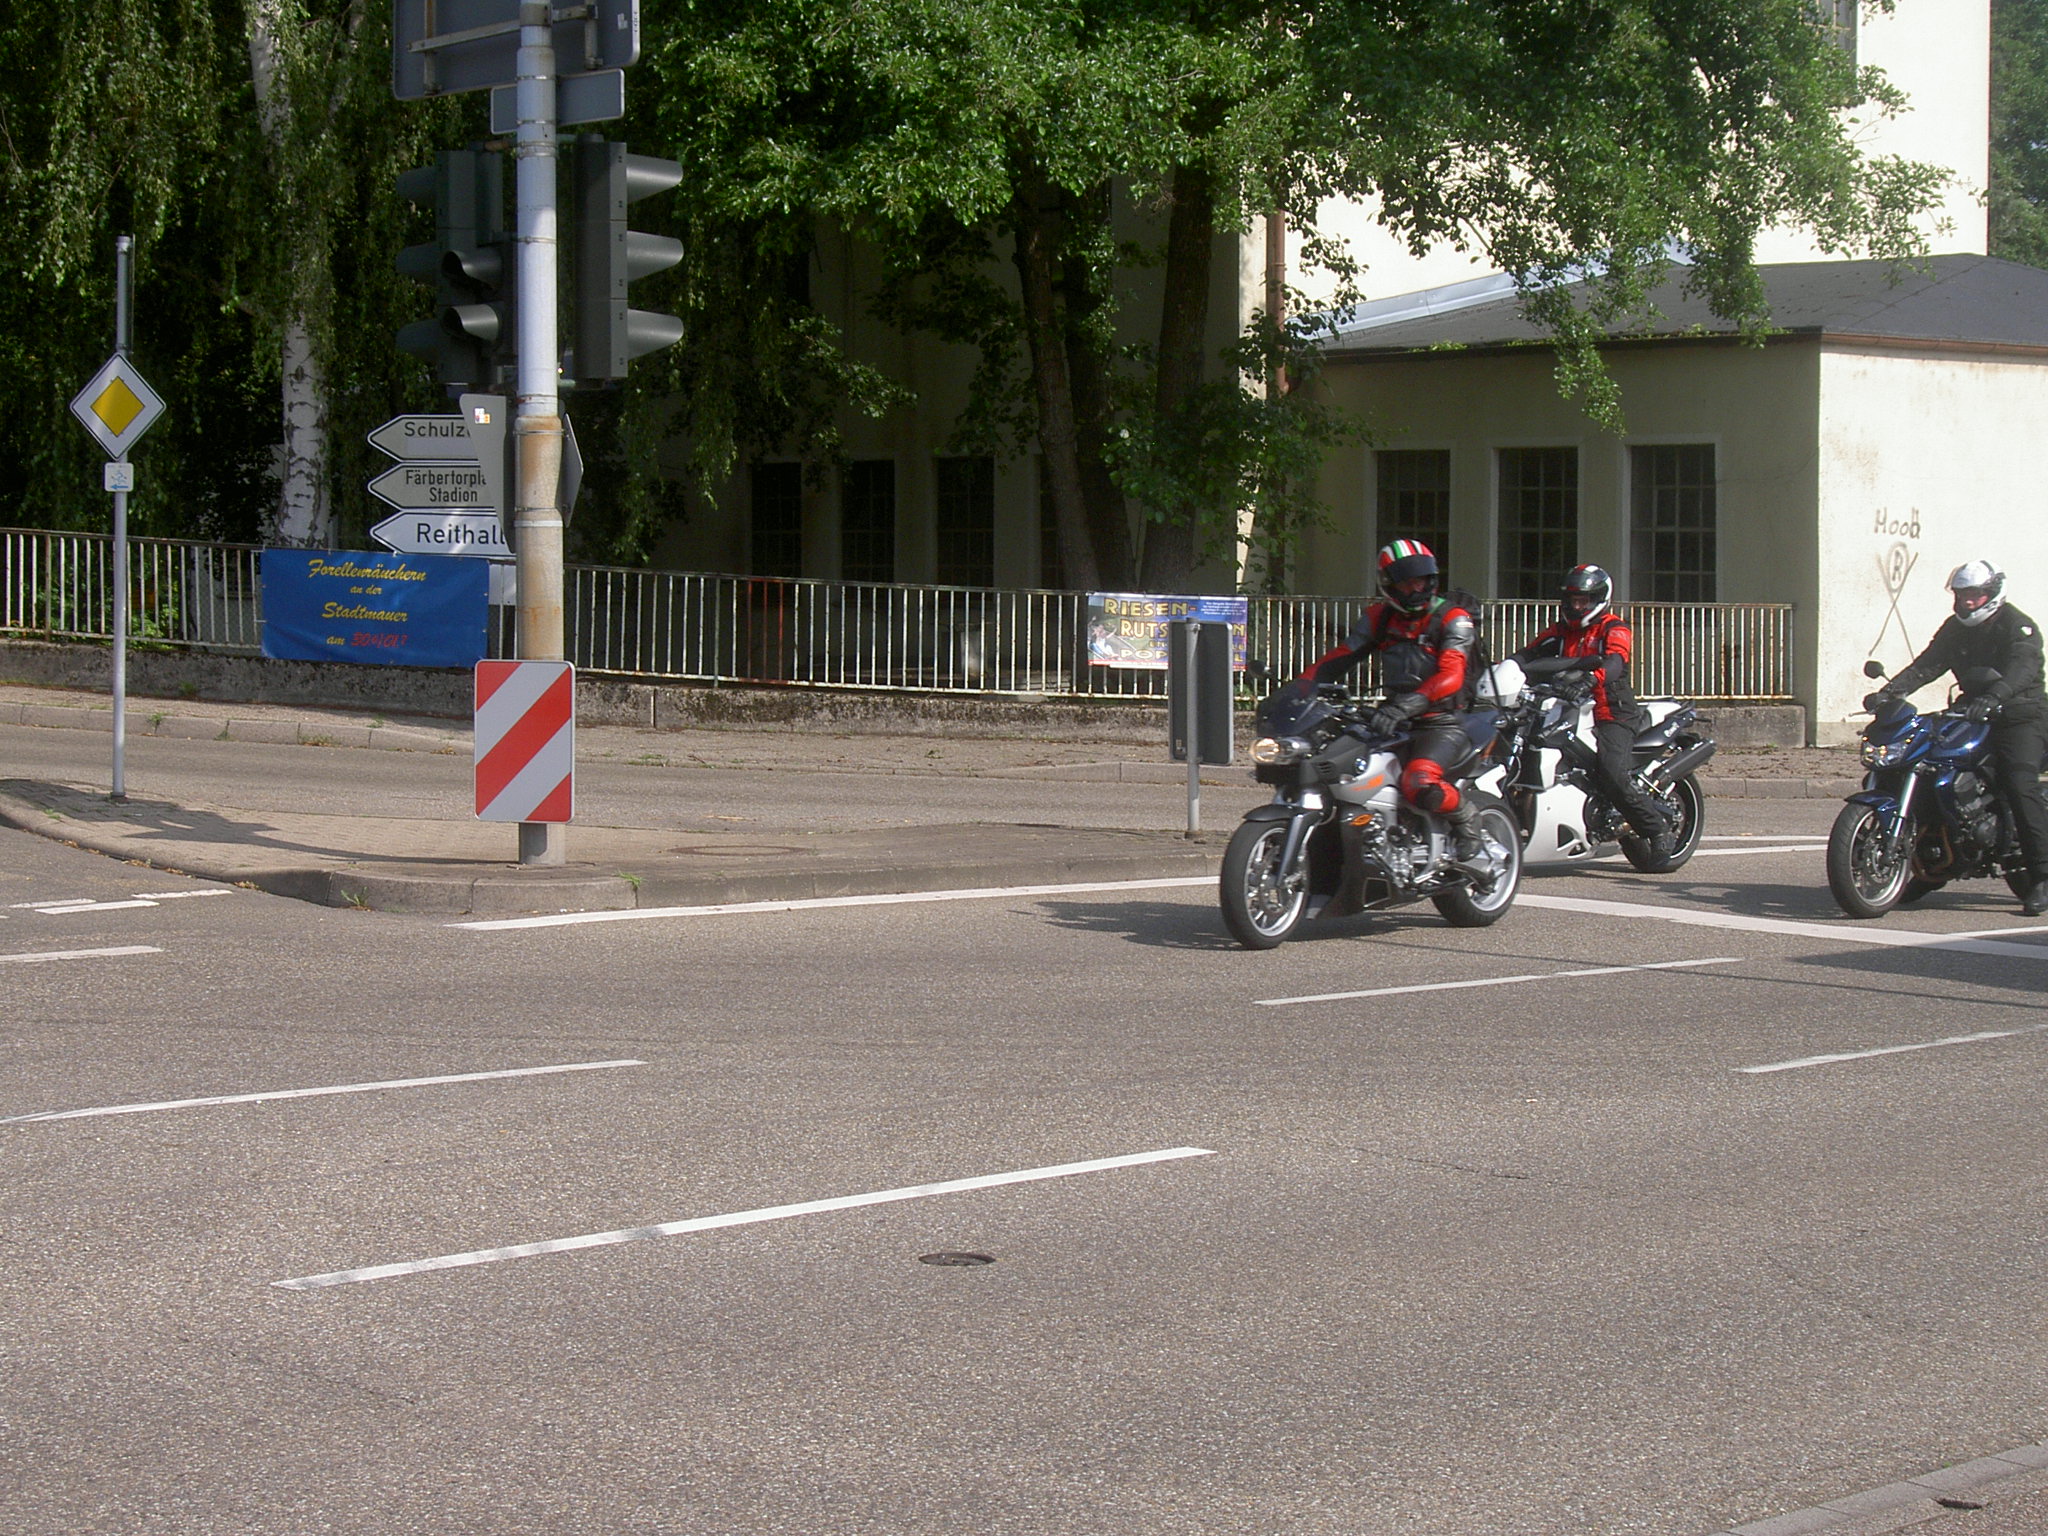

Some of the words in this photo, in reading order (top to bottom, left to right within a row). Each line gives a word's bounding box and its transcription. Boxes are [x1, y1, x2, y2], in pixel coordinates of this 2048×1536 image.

[404, 422, 470, 437] Schulz
[429, 487, 478, 502] Stadion
[417, 523, 505, 545] Reithall
[308, 559, 427, 582] Forellenräuchern
[350, 586, 363, 595] an
[365, 585, 384, 595] der
[321, 602, 408, 622] Stadtmauer
[326, 634, 345, 646] am
